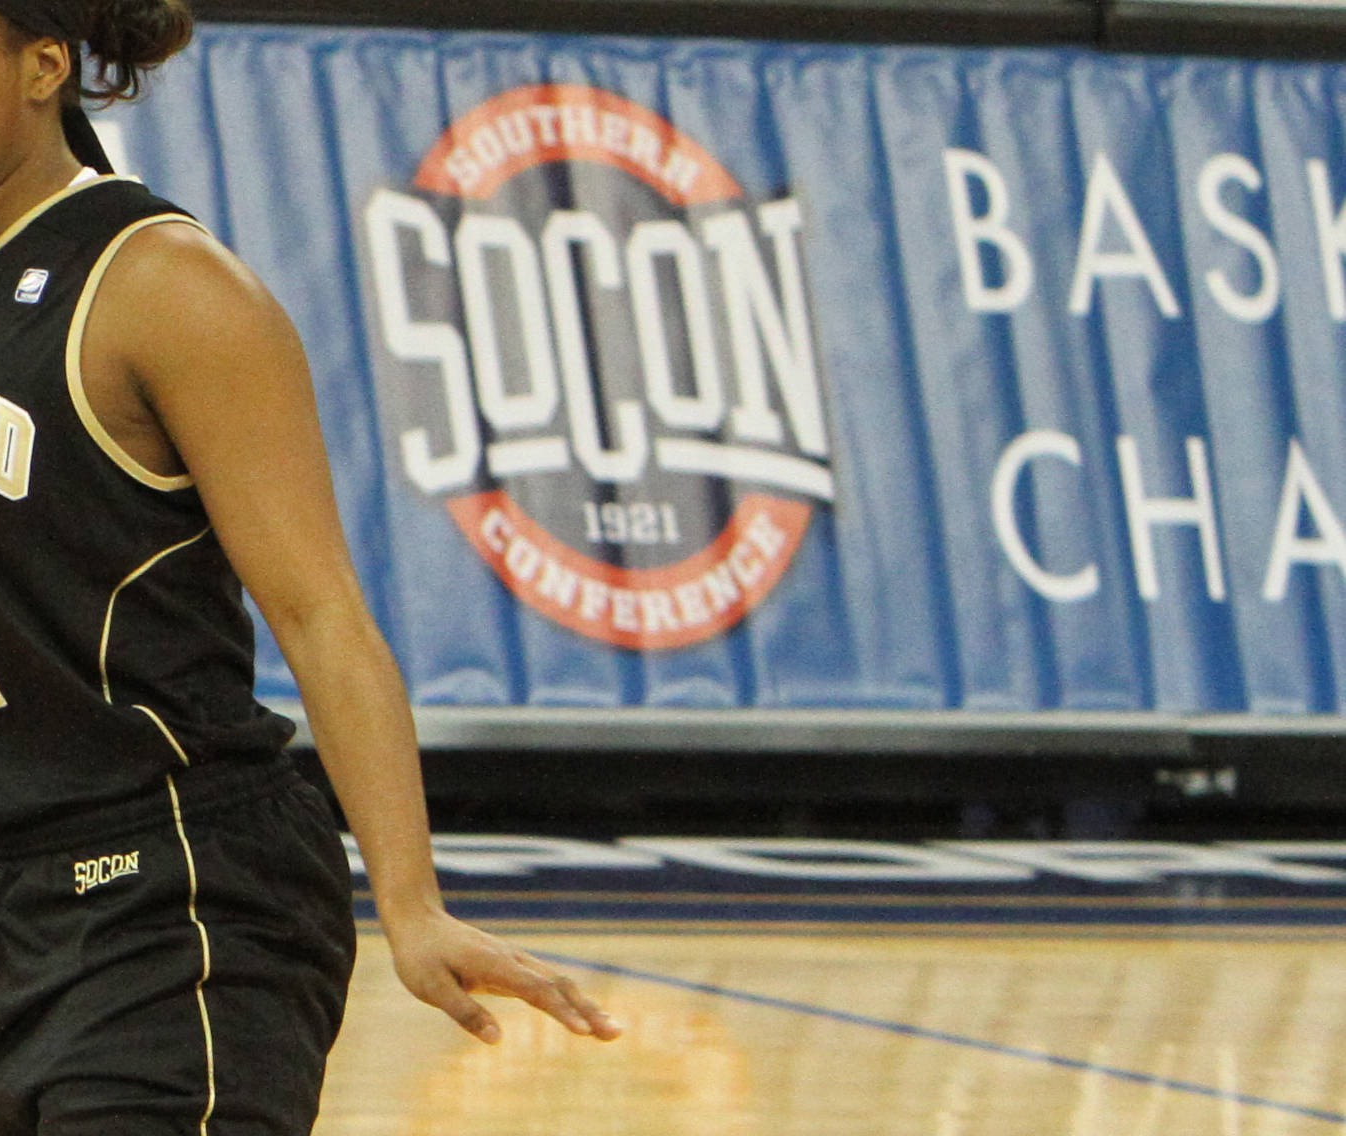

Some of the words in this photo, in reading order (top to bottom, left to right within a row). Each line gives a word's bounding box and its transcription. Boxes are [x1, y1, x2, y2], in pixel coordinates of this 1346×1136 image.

[444, 103, 702, 193] SOUTHERN
[365, 187, 832, 497] SOCON
[584, 502, 681, 544] 1921
[990, 428, 1346, 602] CHA
[480, 508, 787, 634] CONFERENCE
[74, 851, 139, 894] SOCON
